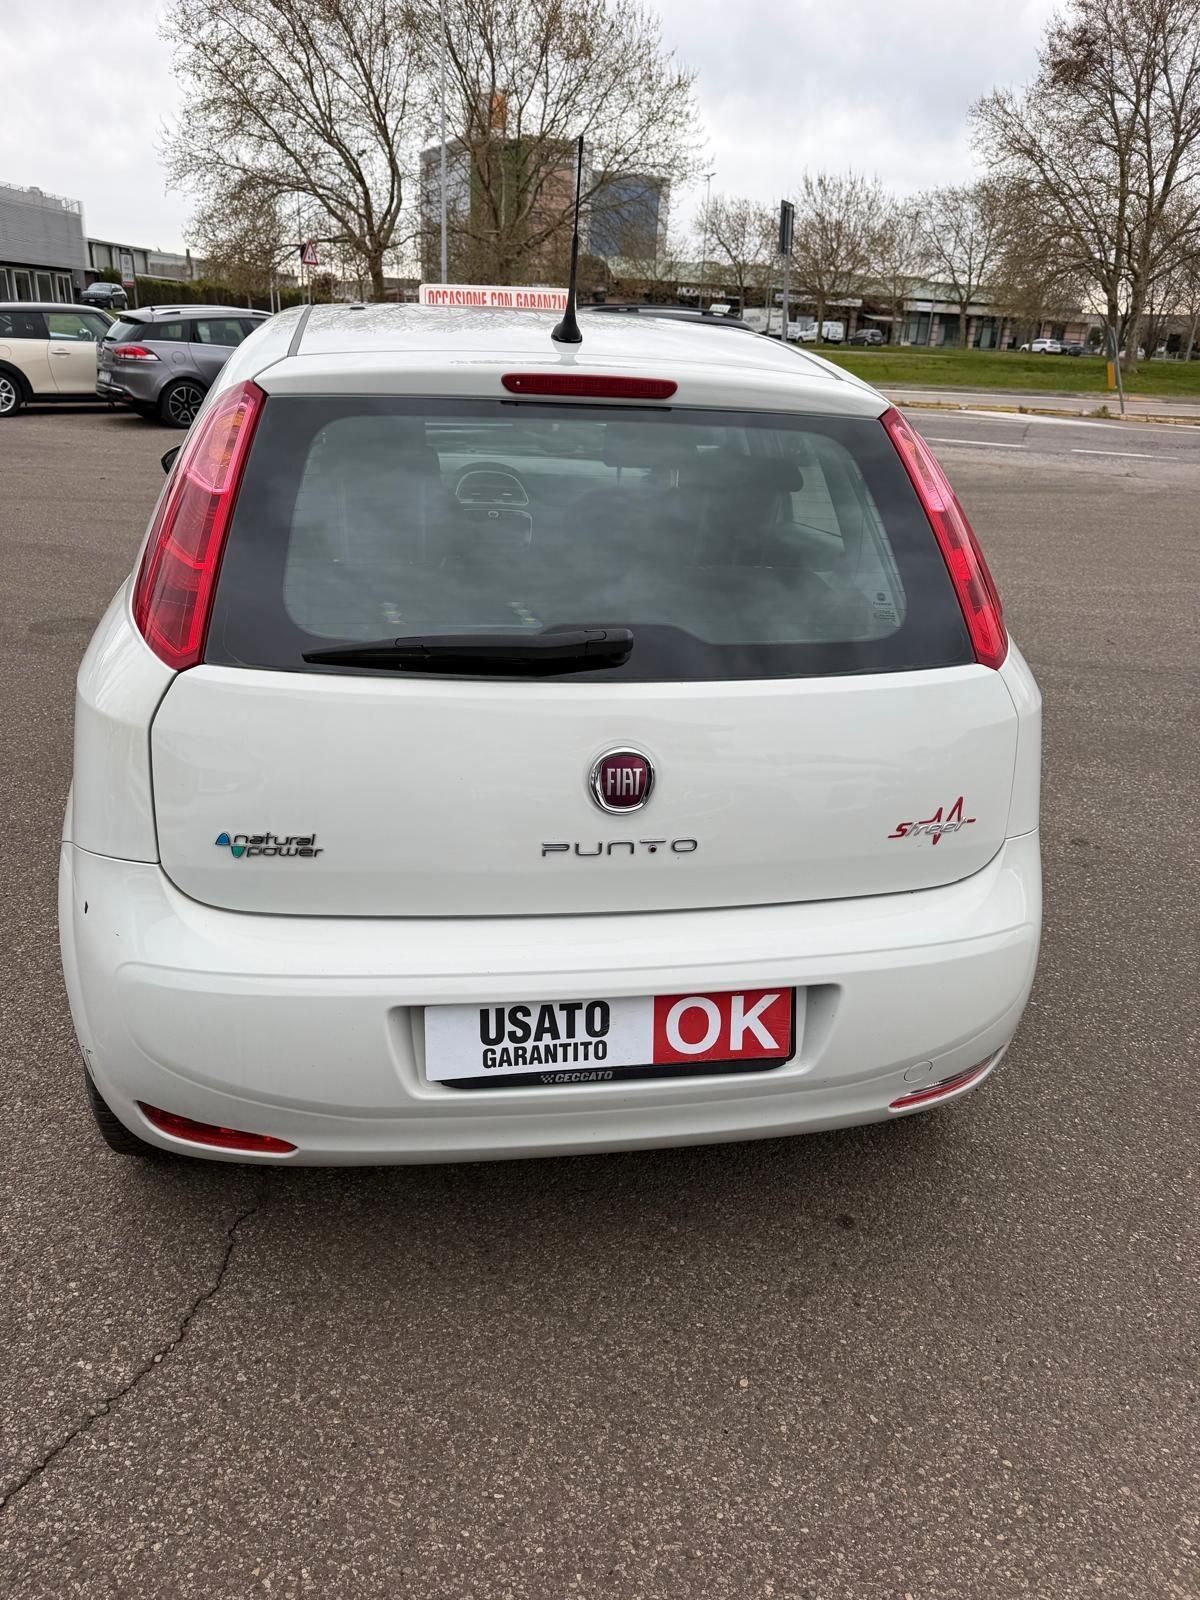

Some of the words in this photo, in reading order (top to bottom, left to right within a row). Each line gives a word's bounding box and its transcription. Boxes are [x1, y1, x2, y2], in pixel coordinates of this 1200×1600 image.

[428, 289, 487, 305] OCCASIONE
[490, 292, 513, 306] CON
[606, 768, 643, 796] FIAT
[233, 832, 316, 846] natural
[541, 838, 698, 857] PUNTO
[246, 846, 324, 858] power
[479, 1000, 610, 1047] USATO
[665, 993, 781, 1055] OK
[482, 1039, 608, 1069] GARANTITO
[555, 1071, 614, 1083] CECCATO
